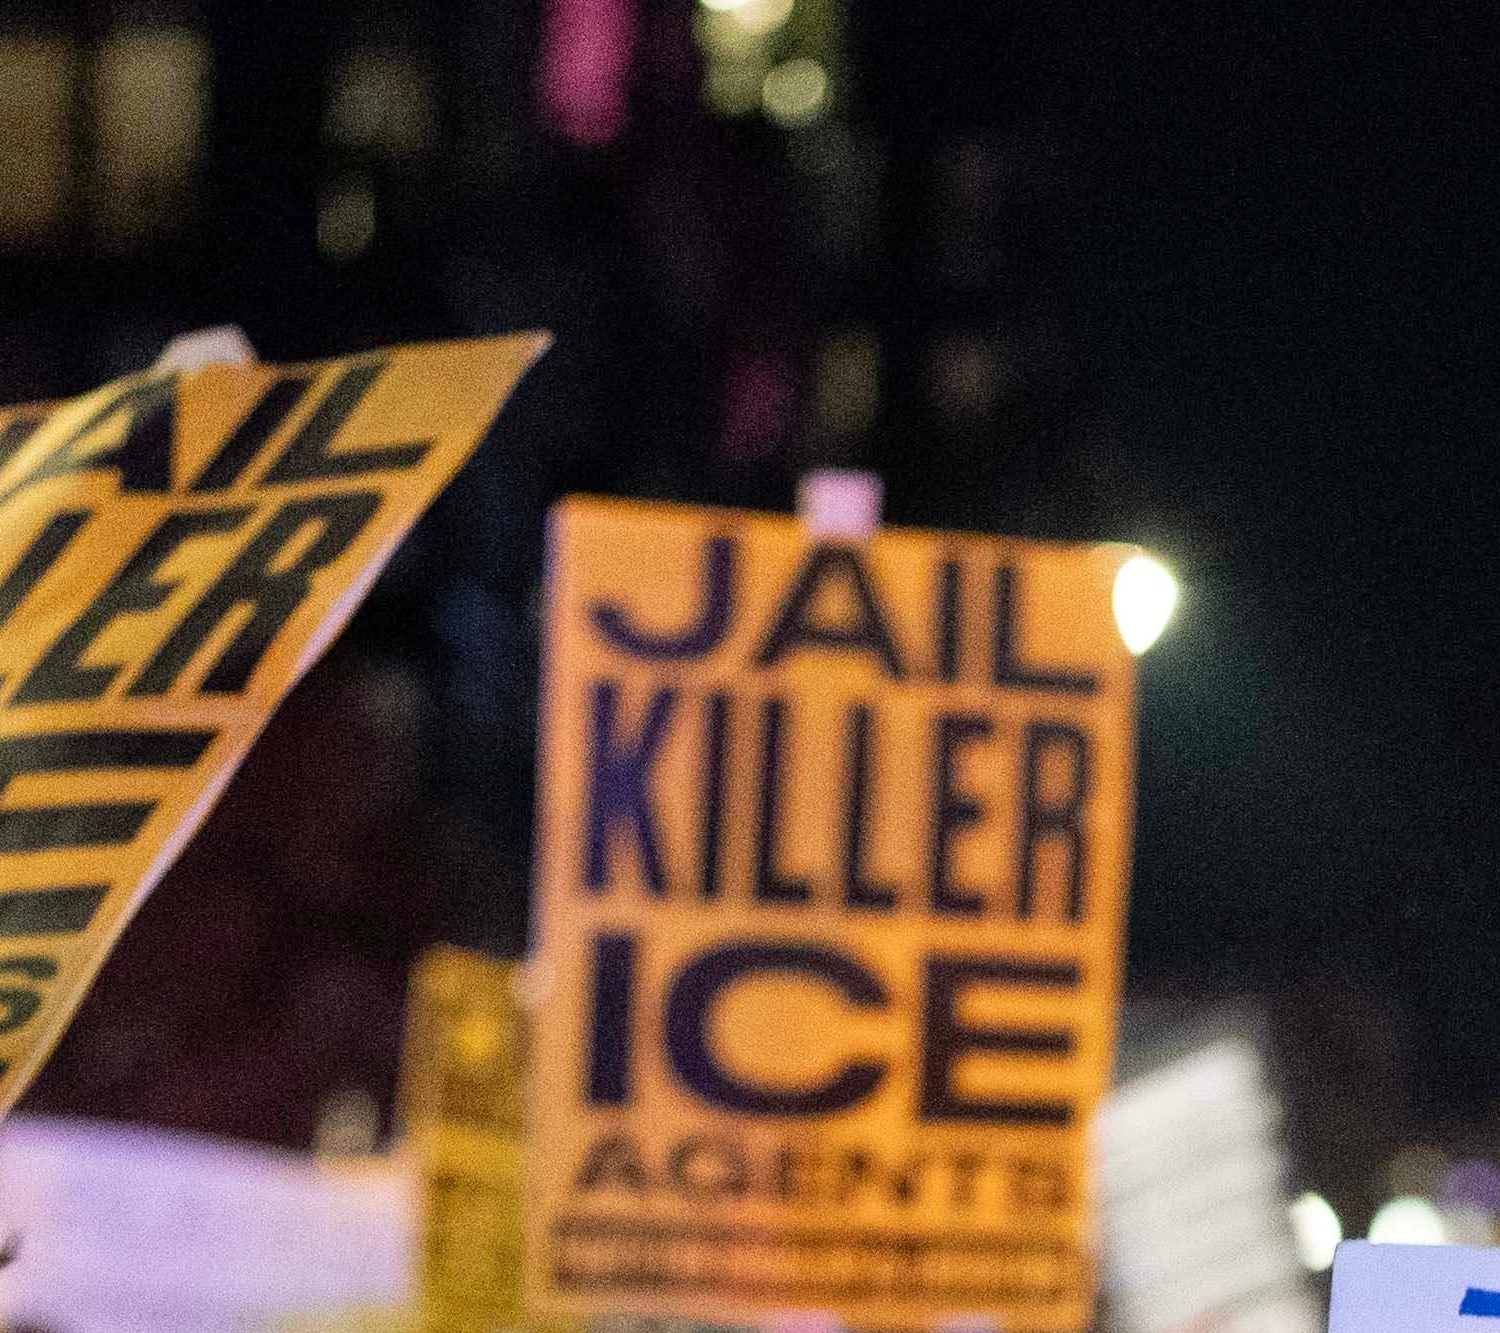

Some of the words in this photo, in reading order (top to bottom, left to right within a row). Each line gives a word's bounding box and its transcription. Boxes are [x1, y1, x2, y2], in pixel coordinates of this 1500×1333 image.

[586, 535, 1102, 697] JAIL
[583, 678, 1095, 928] KILLER
[586, 927, 1083, 1128] ICE
[572, 1130, 1075, 1213] AGENTS
